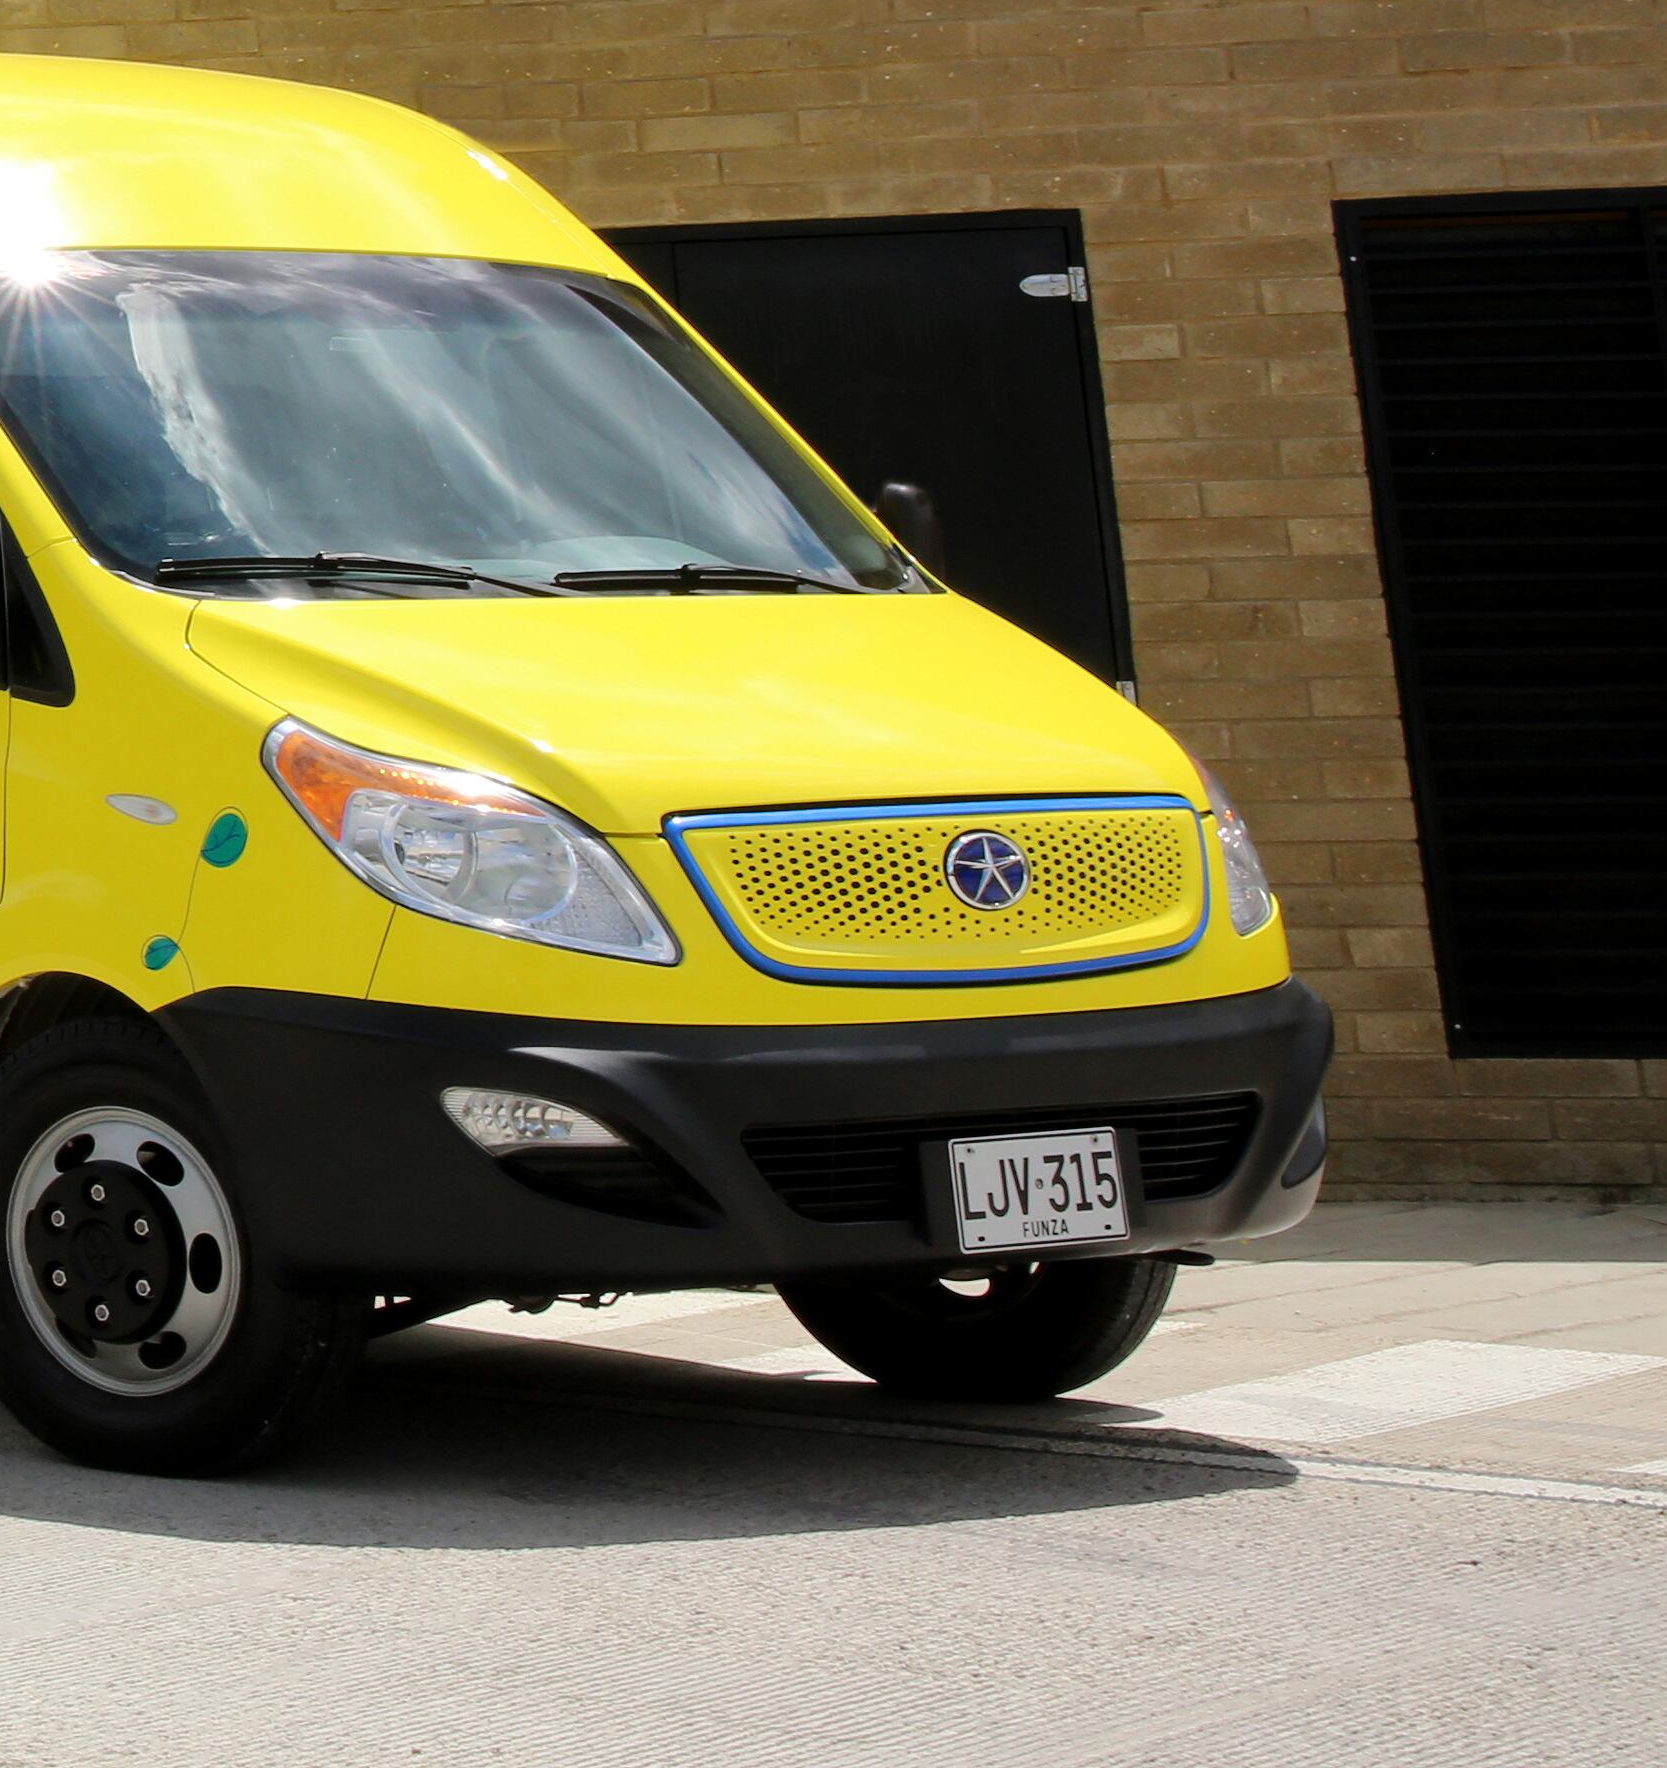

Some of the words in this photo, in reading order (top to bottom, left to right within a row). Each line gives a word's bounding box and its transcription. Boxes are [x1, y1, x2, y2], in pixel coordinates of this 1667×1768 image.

[958, 1157, 1029, 1221] LJV
[1043, 1151, 1119, 1213] 315
[1022, 1218, 1070, 1238] FUNZA
